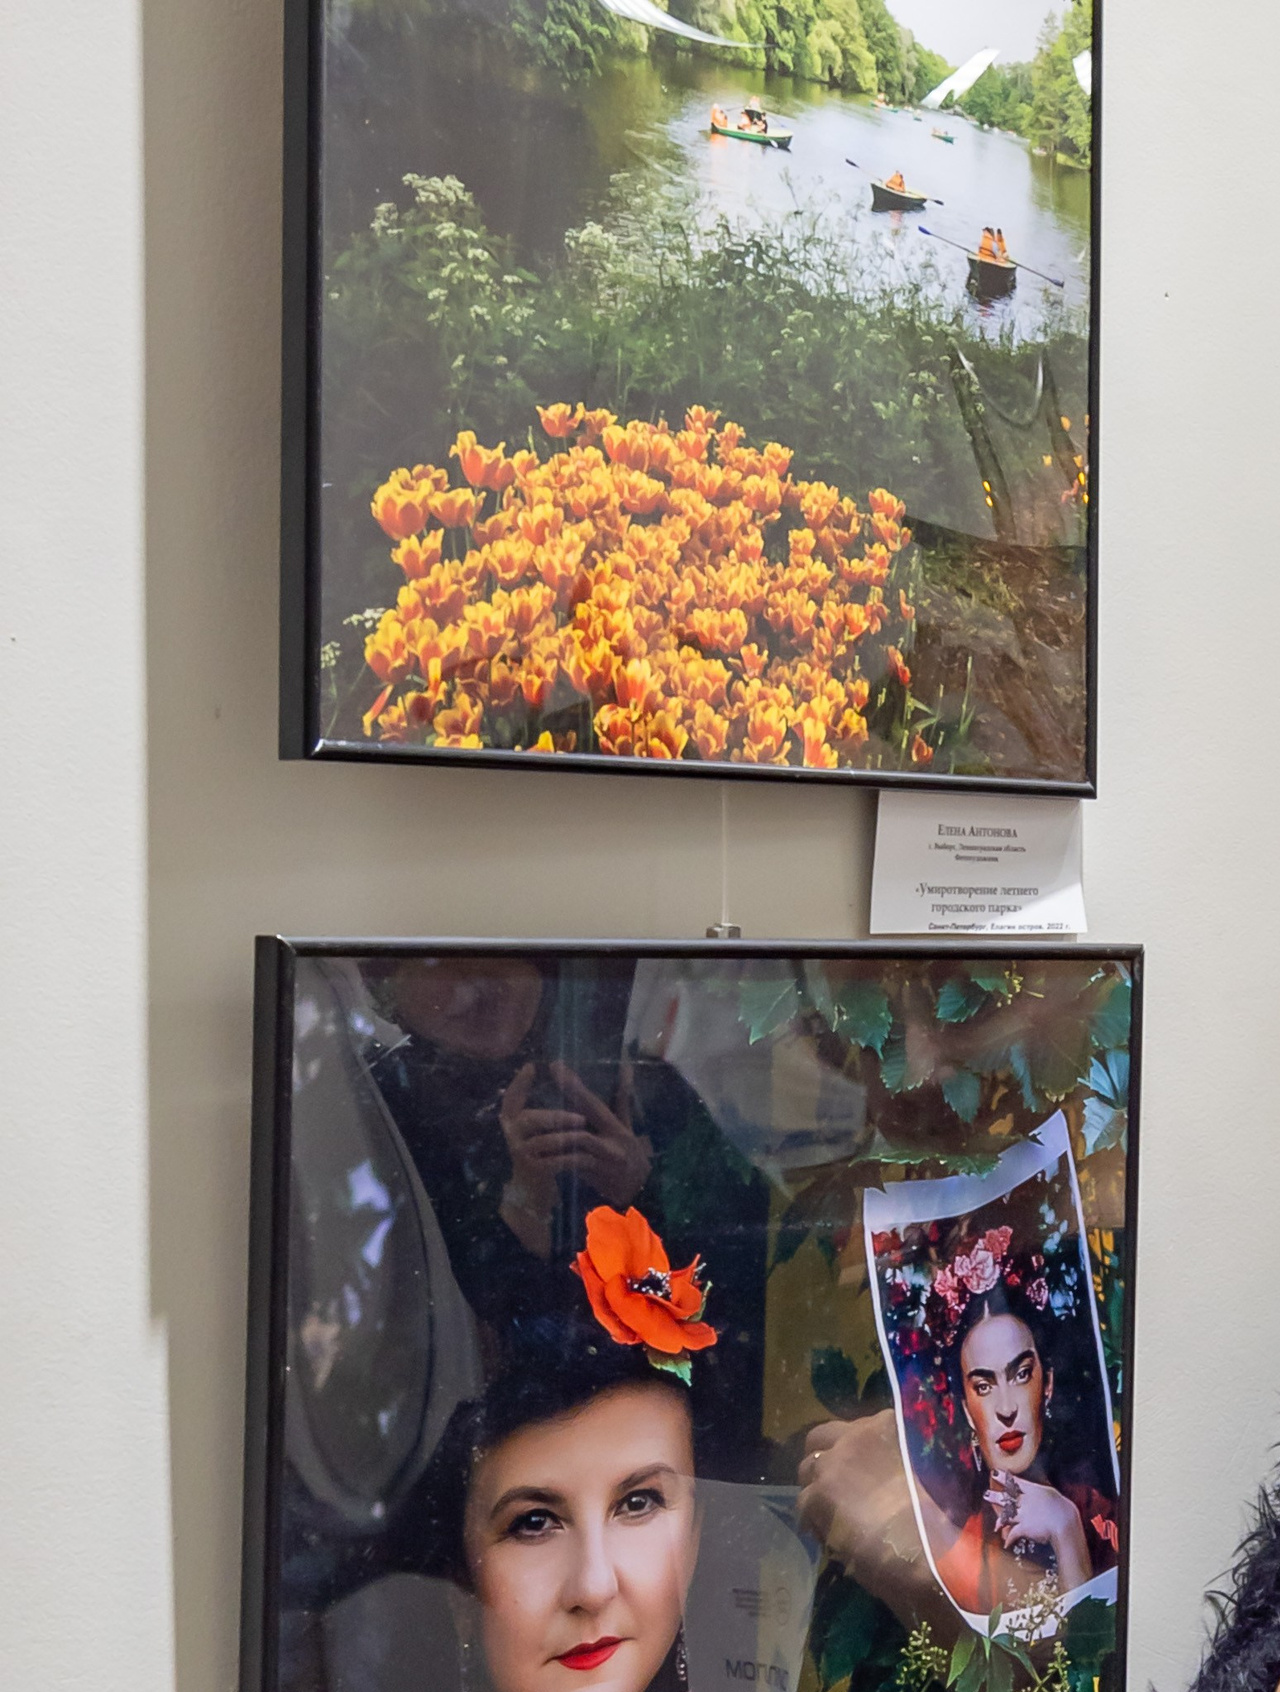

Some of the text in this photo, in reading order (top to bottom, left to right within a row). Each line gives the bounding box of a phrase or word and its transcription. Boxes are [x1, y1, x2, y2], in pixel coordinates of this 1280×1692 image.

[938, 824, 1018, 838] ЕЛЕНА АНТОНОВА
[1000, 887, 1039, 897] летнего
[931, 903, 986, 916] городского
